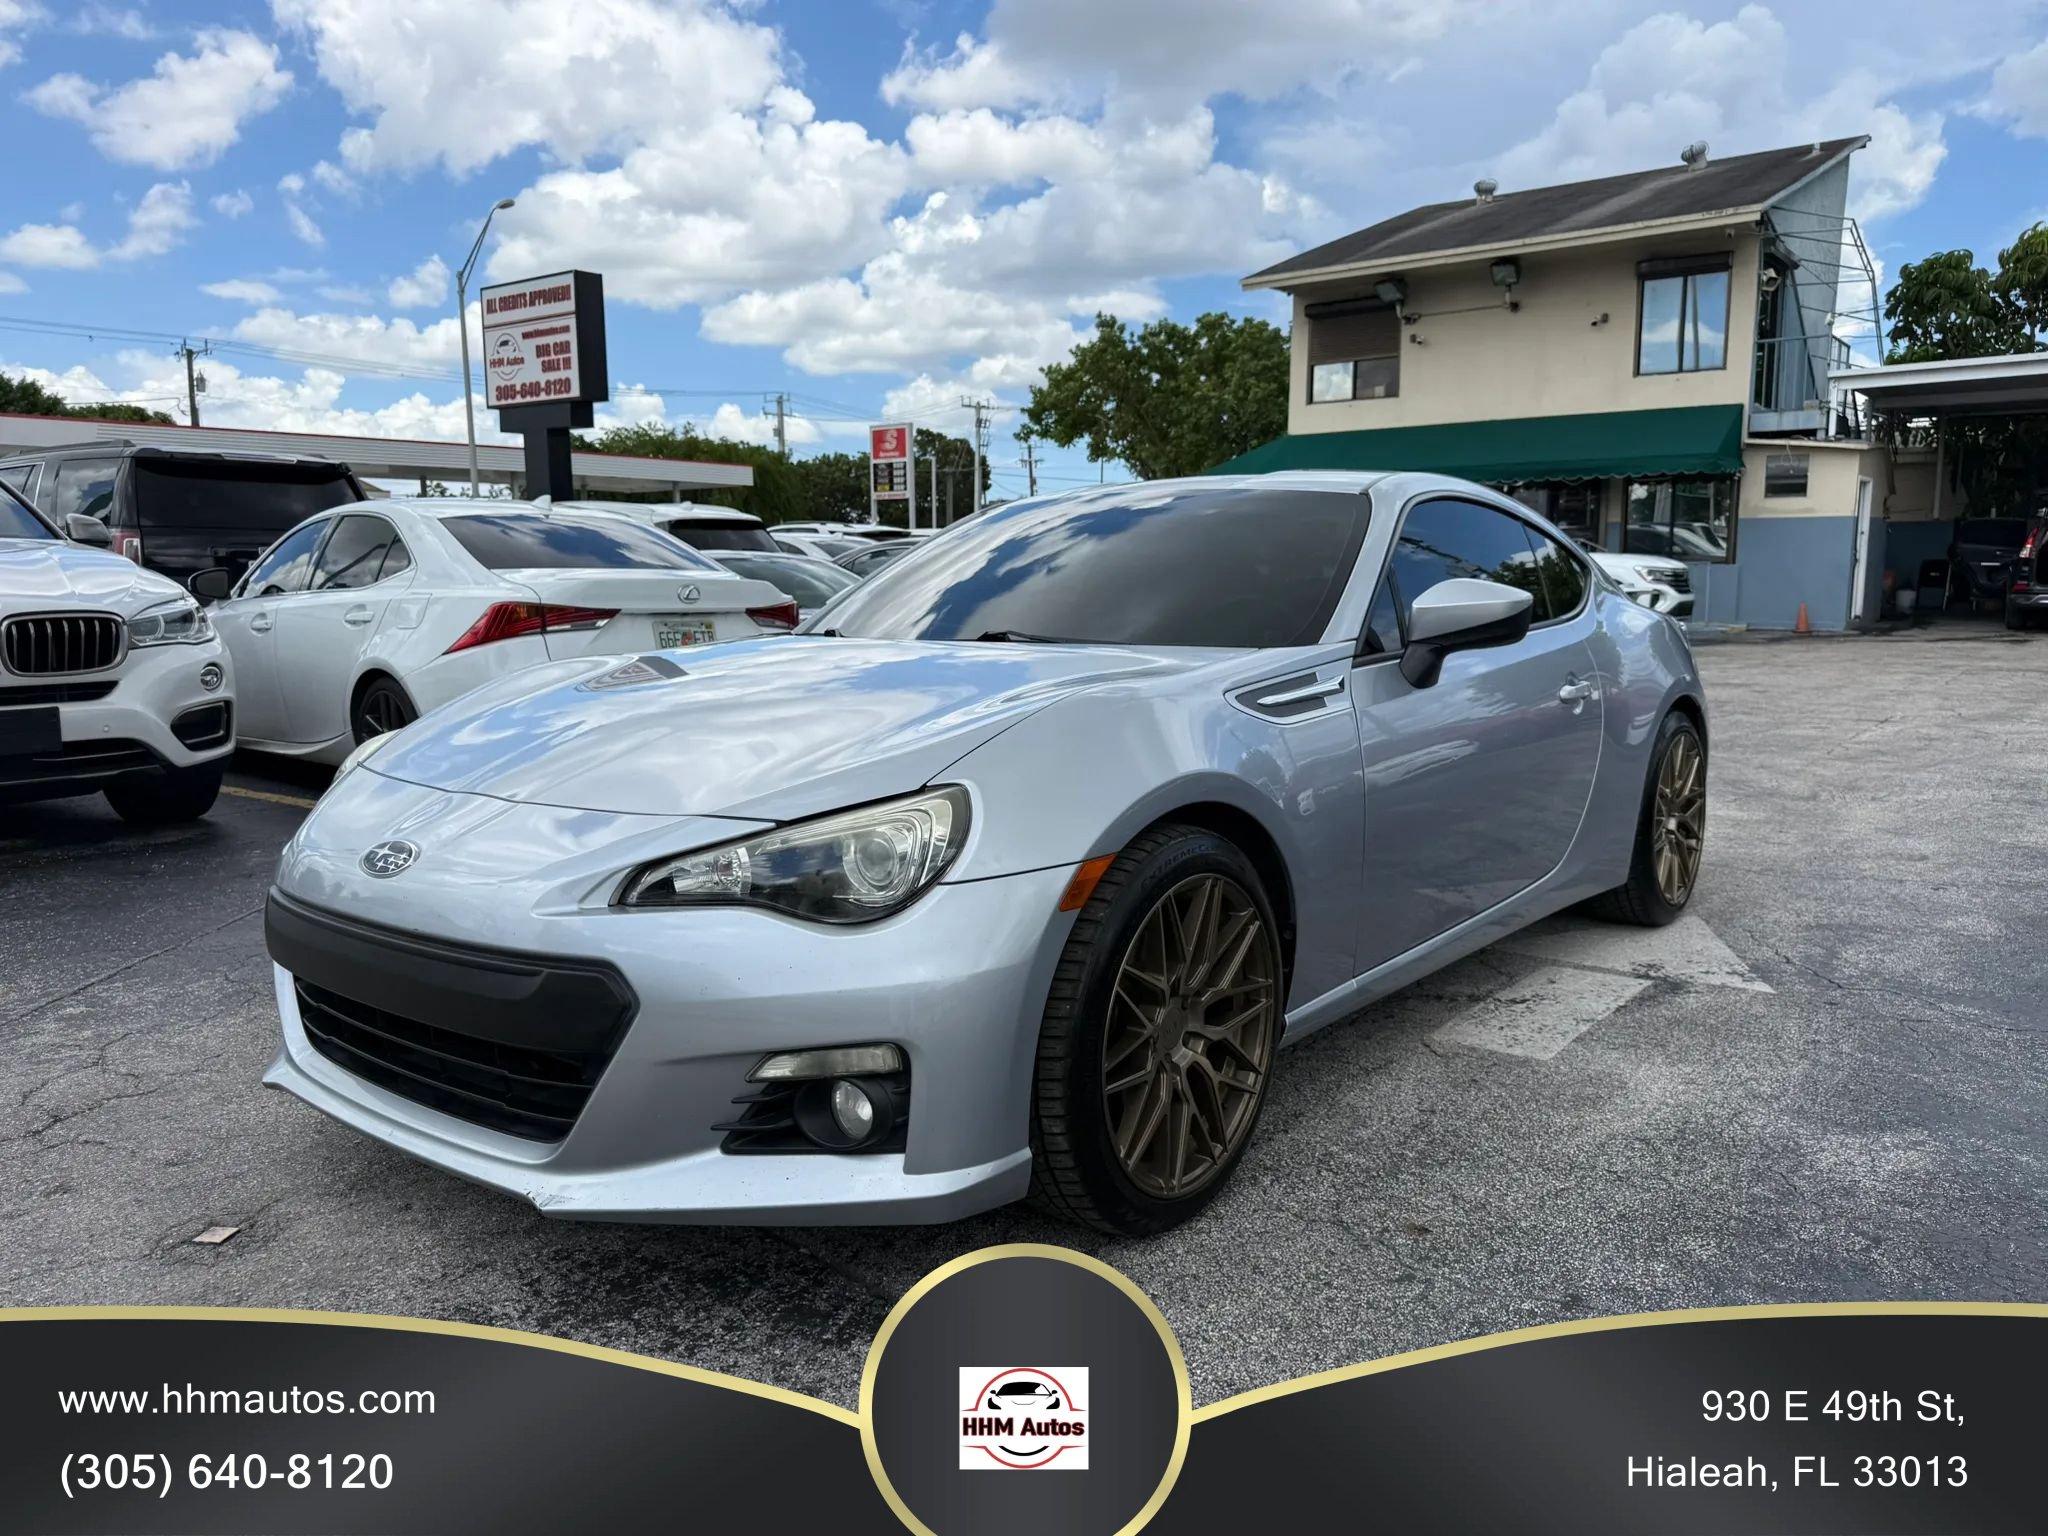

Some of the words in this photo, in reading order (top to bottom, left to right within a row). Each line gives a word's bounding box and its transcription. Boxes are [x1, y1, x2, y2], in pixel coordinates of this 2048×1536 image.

[486, 297, 498, 315] ALL
[499, 293, 528, 312] CREDITS
[536, 343, 551, 358] BIG
[553, 341, 571, 355] CAR
[542, 358, 561, 373] SALE
[496, 378, 571, 401] 305-640-8120
